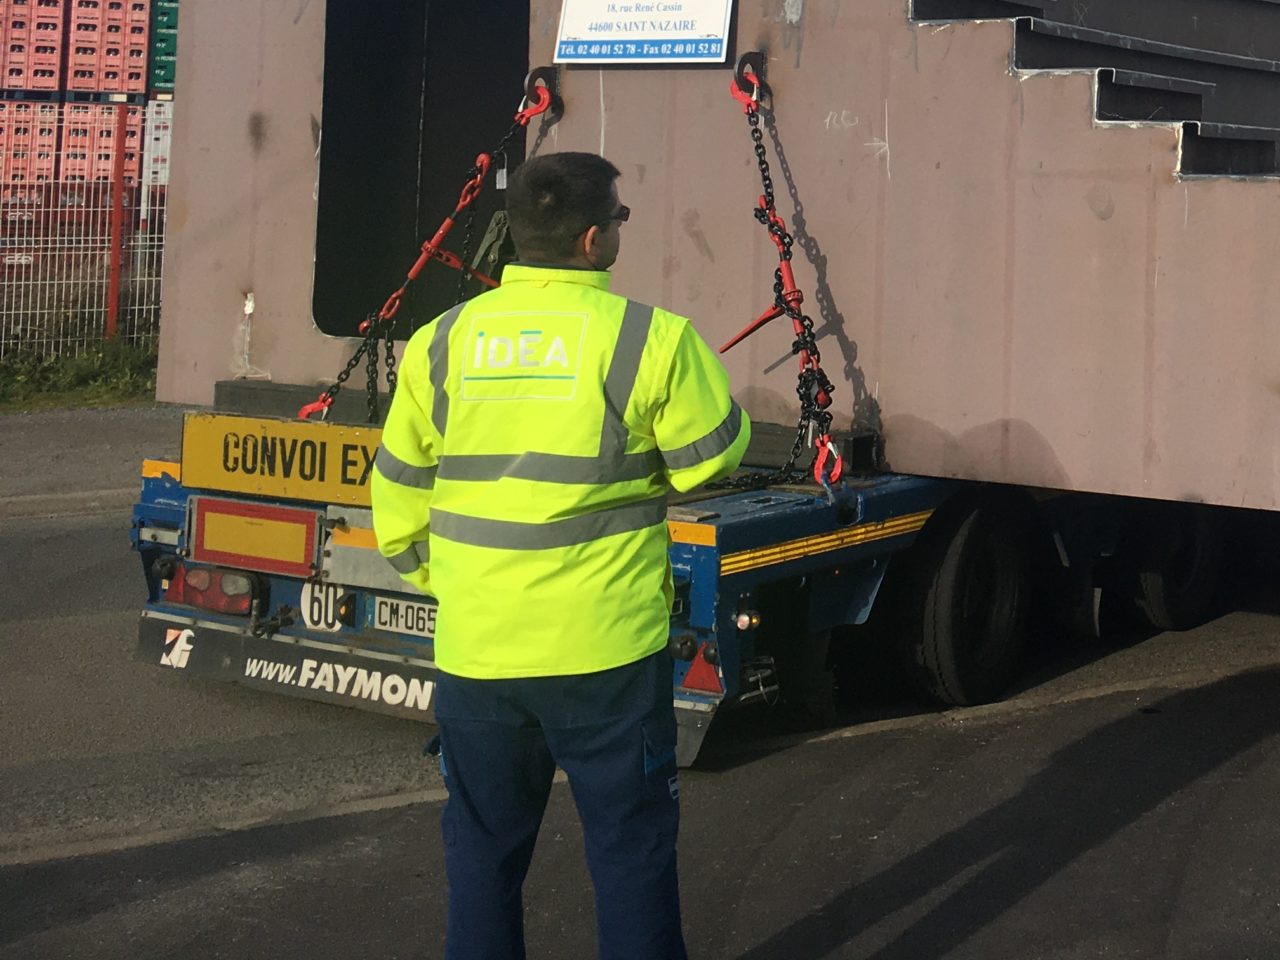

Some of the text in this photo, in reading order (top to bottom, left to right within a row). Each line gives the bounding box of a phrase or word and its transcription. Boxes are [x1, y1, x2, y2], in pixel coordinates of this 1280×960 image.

[587, 19, 697, 33] 44600 SAINT NAZAIRE
[607, 2, 683, 14] 18, rue René Cassin
[577, 44, 588, 55] 02
[589, 44, 601, 55] 40
[601, 44, 611, 54] 01
[613, 44, 624, 54] 52
[626, 44, 636, 54] 78
[643, 44, 659, 54] Fax
[661, 44, 672, 54] 02
[673, 44, 684, 54] 40
[685, 44, 695, 54] 01
[698, 43, 709, 54] 52
[710, 43, 721, 53] 81
[474, 331, 569, 369] IDEA
[222, 431, 380, 486] CONVOI EX
[309, 580, 338, 629] 60
[244, 657, 437, 711] www.FAYMON
